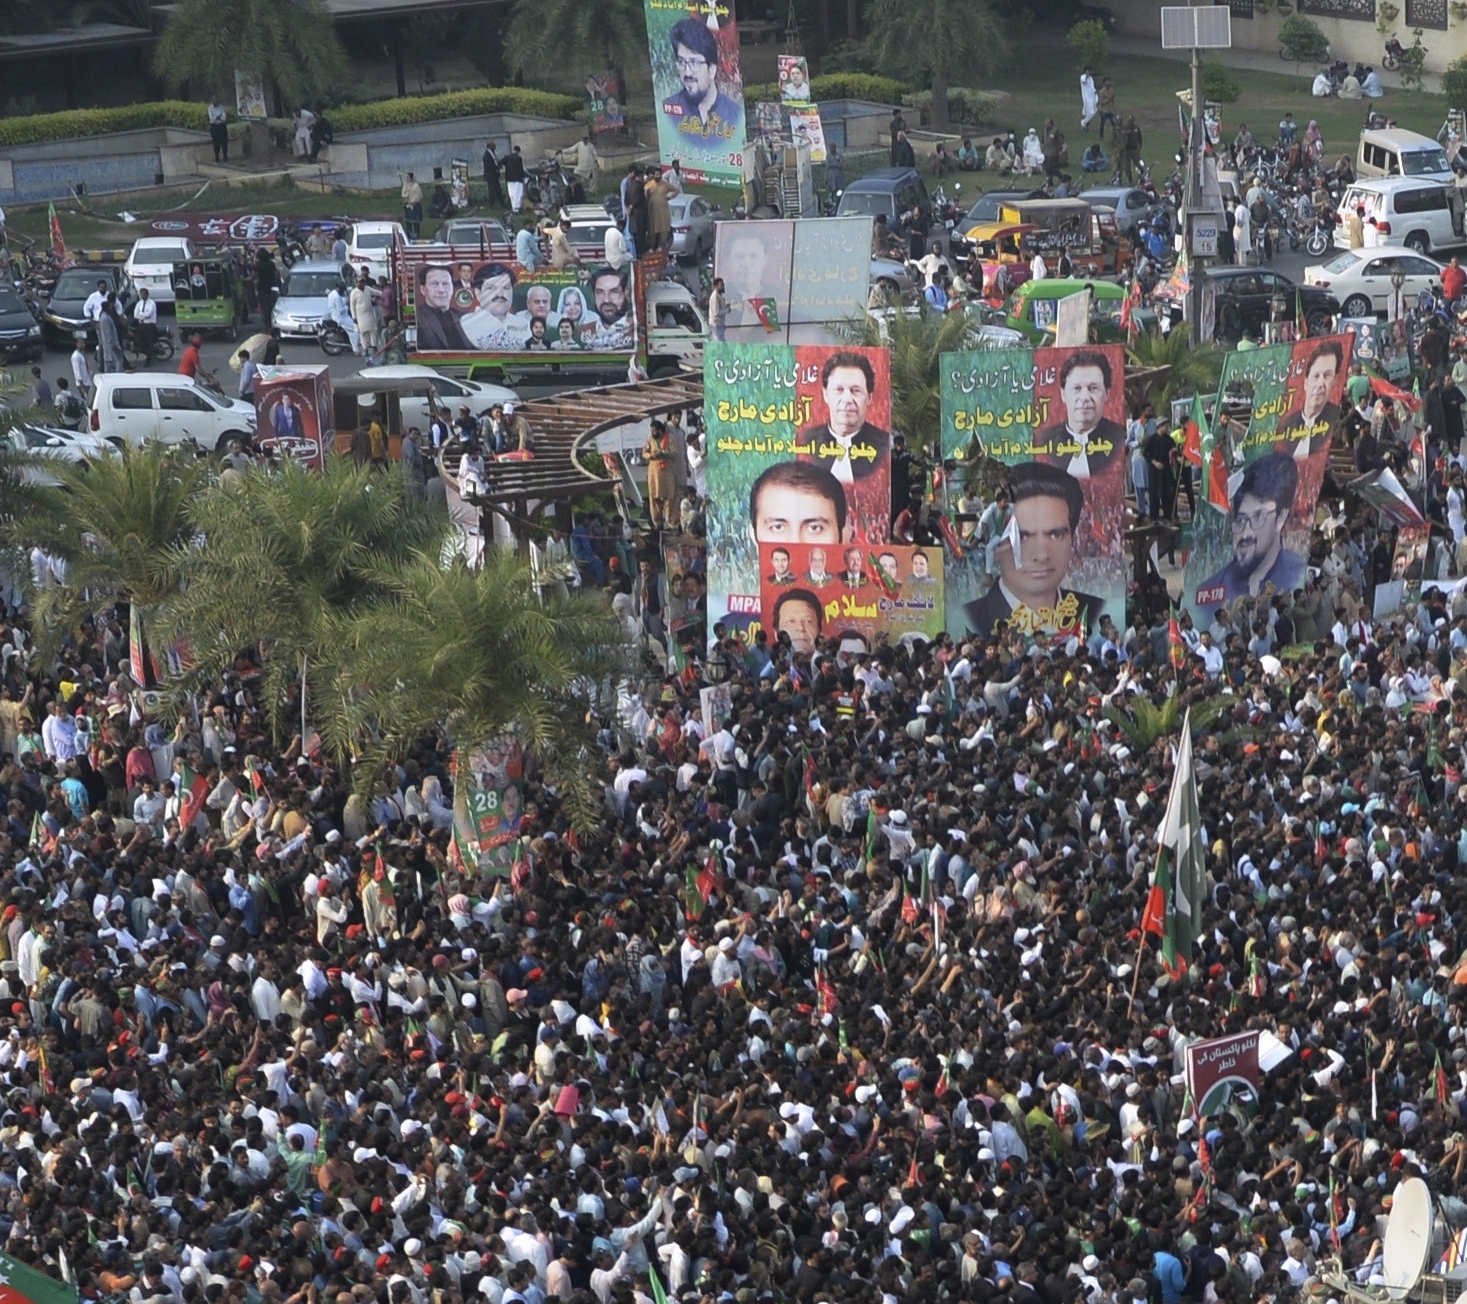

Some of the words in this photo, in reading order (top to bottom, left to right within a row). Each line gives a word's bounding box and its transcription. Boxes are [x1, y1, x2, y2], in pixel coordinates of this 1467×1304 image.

[729, 153, 743, 167] 28
[1201, 241, 1212, 251] 15
[717, 398, 762, 424] مارچ
[763, 396, 813, 426] آزادی
[998, 397, 1050, 429] آزادی
[1254, 388, 1298, 421] آزادی
[953, 404, 998, 432] مارچ
[716, 437, 745, 456] چلو
[818, 442, 847, 461] چلو
[848, 443, 878, 462] چلو
[1056, 438, 1085, 459] چلو
[1086, 438, 1114, 457] چلو
[730, 596, 761, 611] MPA
[474, 791, 497, 813] 28
